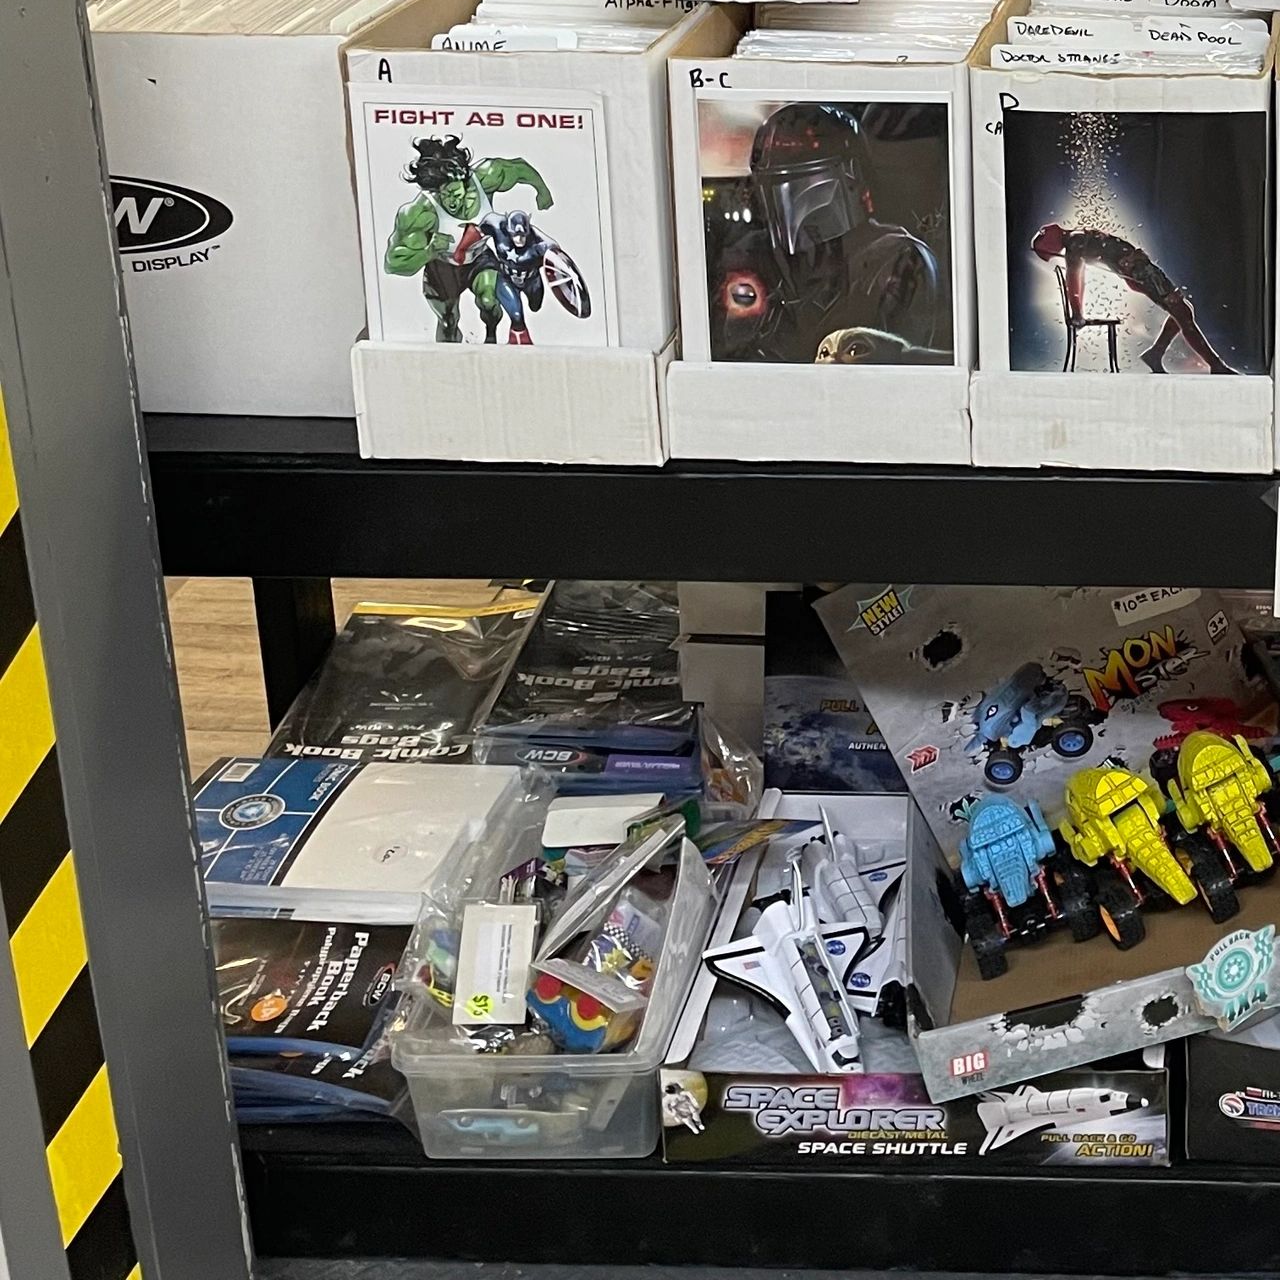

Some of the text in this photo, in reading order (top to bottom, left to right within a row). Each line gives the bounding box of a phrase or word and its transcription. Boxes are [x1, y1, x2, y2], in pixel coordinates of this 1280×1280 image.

[1014, 21, 1094, 37] DAREDEVIL
[1148, 30, 1242, 45] DEAD POOL
[999, 50, 1051, 63] DOCTOR
[378, 57, 392, 83] A
[689, 68, 732, 89] B-C
[374, 109, 583, 129] FIGHT AS ONE!
[864, 592, 898, 622] NEW
[870, 607, 904, 635] STYLE!
[572, 666, 650, 677] Bags
[516, 673, 596, 691] Book
[341, 733, 420, 747] Bags
[283, 742, 468, 761] Comic Book
[524, 749, 573, 760] BCW
[306, 932, 370, 1032] Paperback
[306, 960, 343, 1007] Book
[371, 972, 391, 1001] BCW
[952, 1052, 985, 1076] BIG
[724, 1086, 840, 1109] SPACE
[756, 1108, 945, 1135] EXPLORER
[848, 1131, 948, 1139] DIECAST METAL
[1041, 1134, 1070, 1144] PULL
[1073, 1134, 1104, 1144] BACK
[1119, 1134, 1137, 1144] GO
[798, 1142, 968, 1156] SPACE SHUTTLE
[1076, 1143, 1153, 1158] ACTION!
